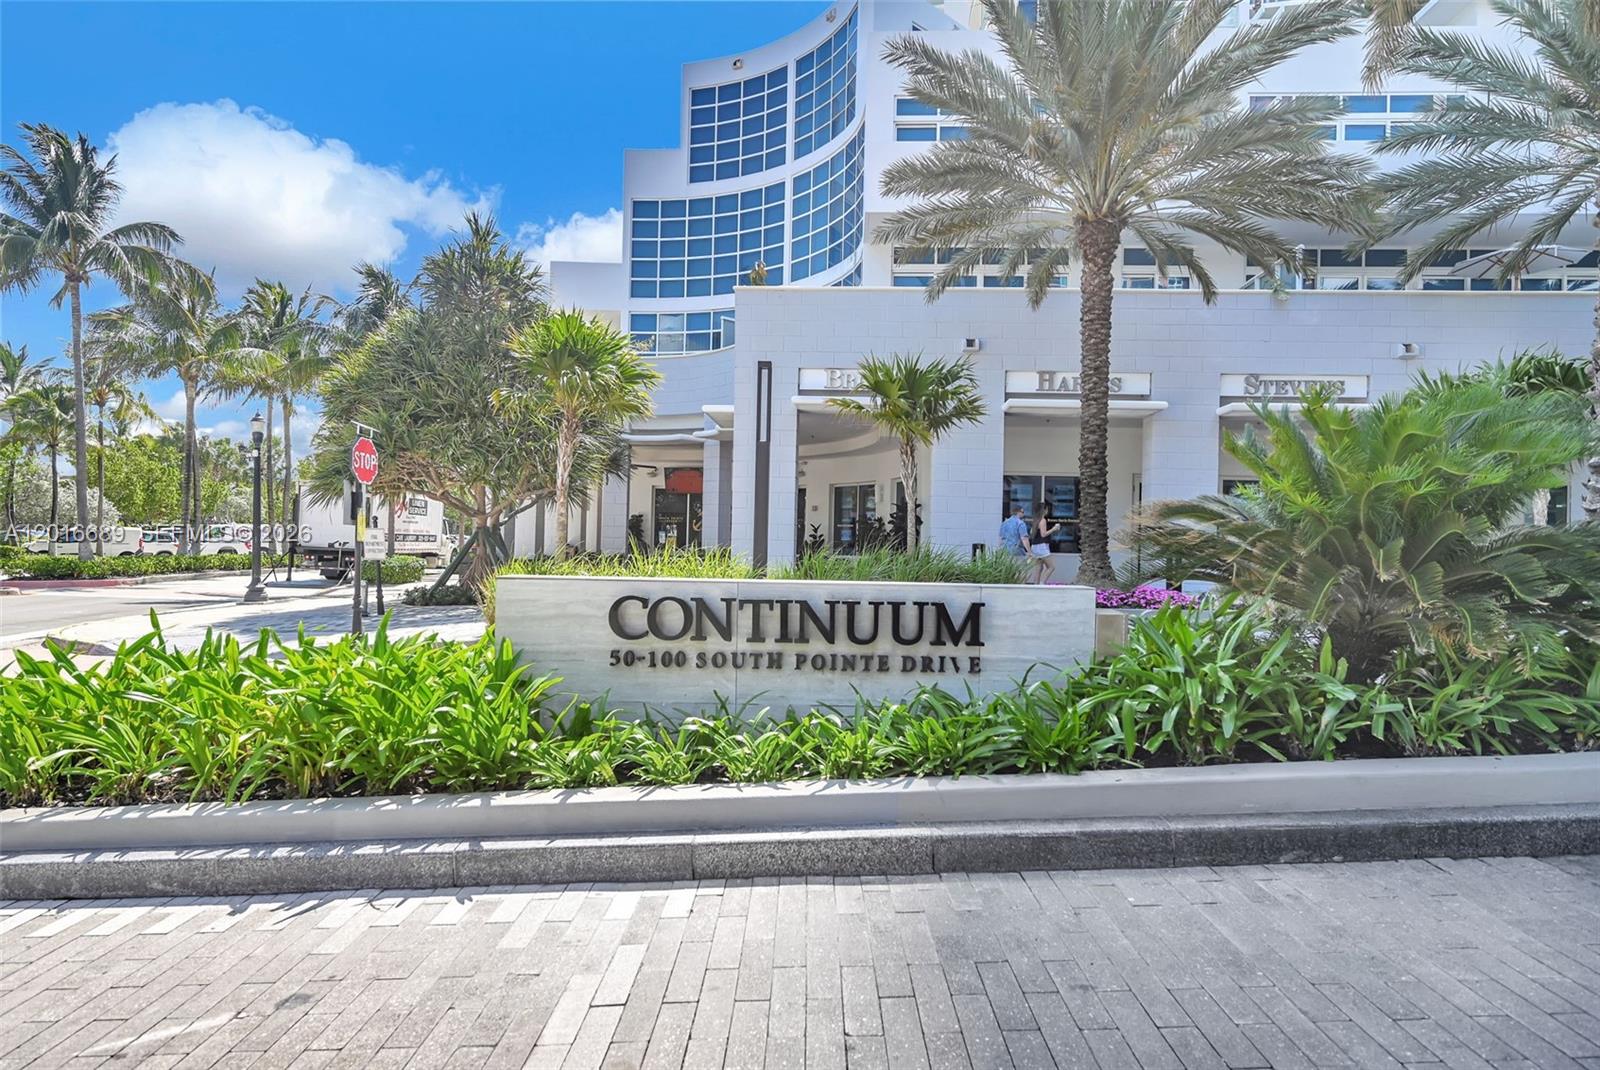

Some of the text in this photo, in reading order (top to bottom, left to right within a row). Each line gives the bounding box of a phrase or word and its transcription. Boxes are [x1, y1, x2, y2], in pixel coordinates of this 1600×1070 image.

[1035, 371, 1121, 392] HARS
[354, 451, 376, 470] STOP
[608, 595, 985, 646] CONTINUUM
[609, 649, 982, 675] 50-100 SOUTH POINTE DRIVE
